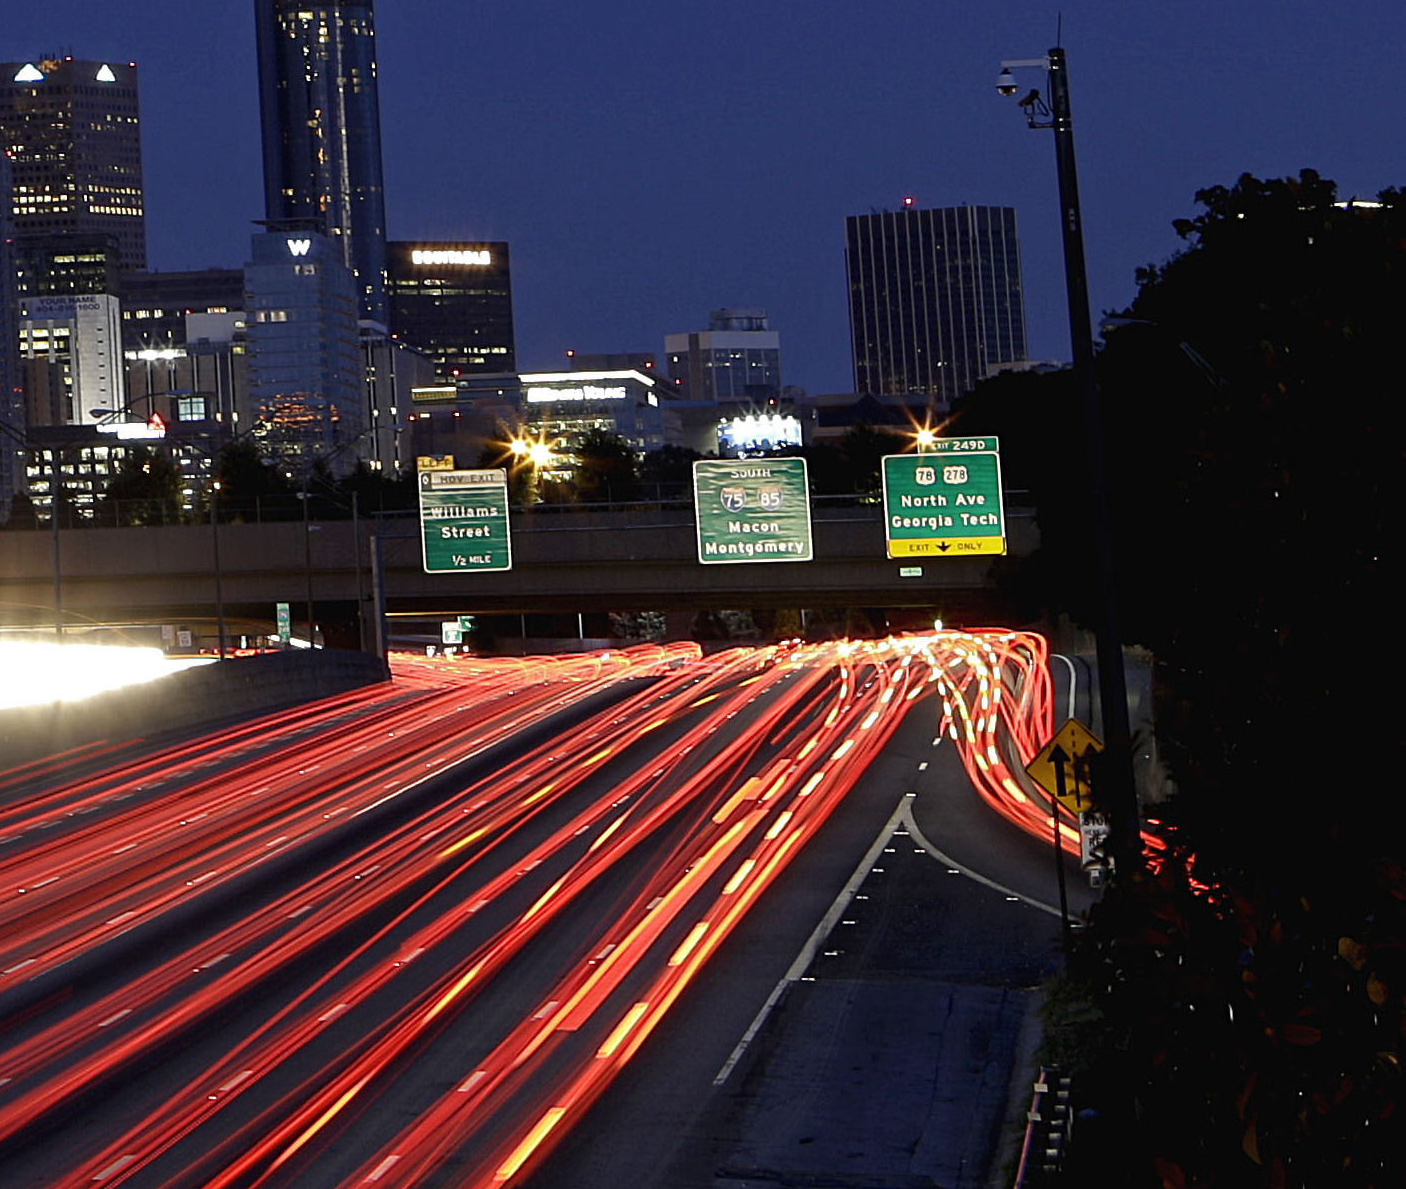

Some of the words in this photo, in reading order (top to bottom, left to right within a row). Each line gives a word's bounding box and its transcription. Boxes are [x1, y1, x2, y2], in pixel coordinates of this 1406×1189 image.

[287, 239, 311, 256] W
[952, 440, 986, 450] 249D
[470, 473, 495, 482] EXIT
[918, 471, 933, 481] 78
[946, 469, 966, 480] 278
[724, 493, 743, 508] 75
[760, 491, 780, 507] 85
[901, 494, 947, 507] North
[955, 493, 986, 506] Ave
[430, 506, 499, 519] Williams
[728, 521, 780, 534] Macon
[892, 515, 953, 531] Georgia
[960, 513, 998, 526] Tech
[441, 526, 490, 539] Street
[705, 542, 804, 555] Montgomery
[909, 543, 929, 552] EXIT
[957, 542, 983, 550] ONLY
[469, 555, 491, 564] MILE
